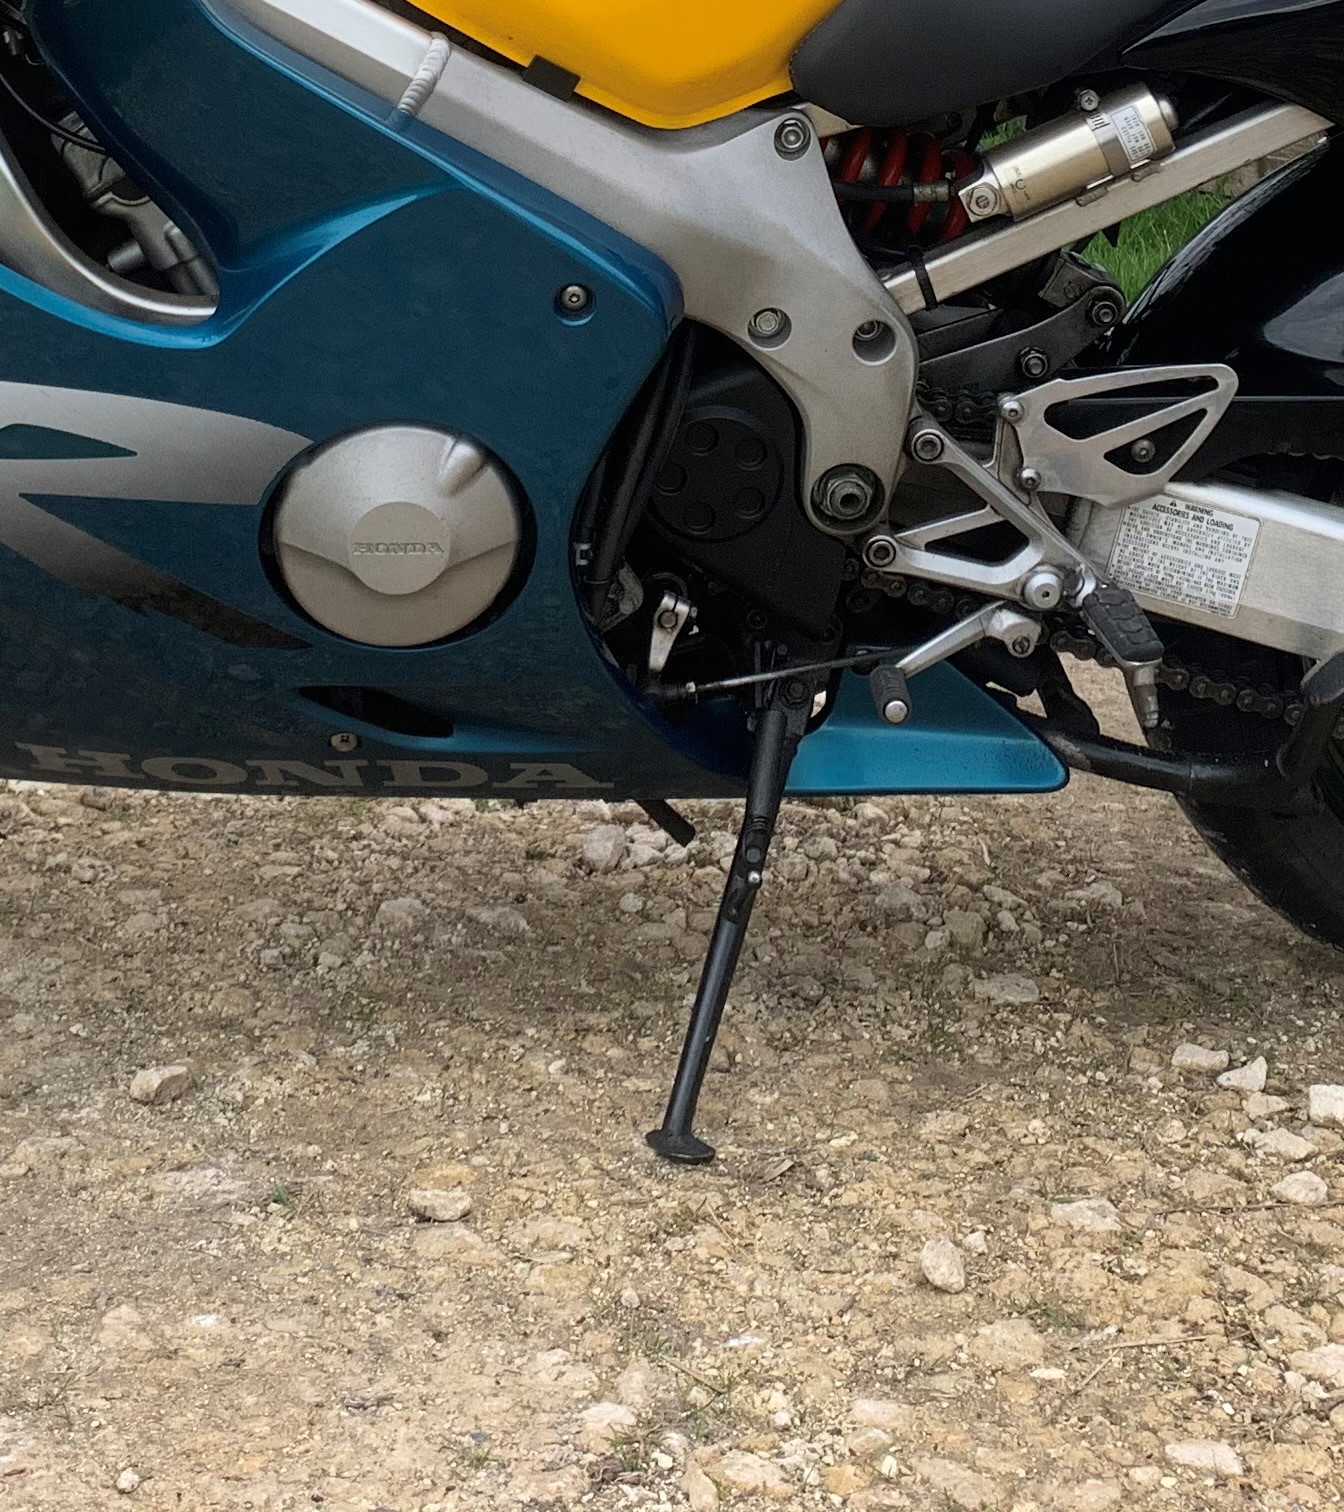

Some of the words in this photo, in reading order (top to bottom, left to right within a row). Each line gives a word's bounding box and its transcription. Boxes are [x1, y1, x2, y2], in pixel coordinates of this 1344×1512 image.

[1152, 504, 1190, 521] ACCESSORIES
[1191, 511, 1205, 523] AND
[1206, 516, 1234, 532] LOADING
[1185, 503, 1213, 517] WARNING
[352, 541, 445, 556] HONDA
[15, 741, 616, 789] HONDA
